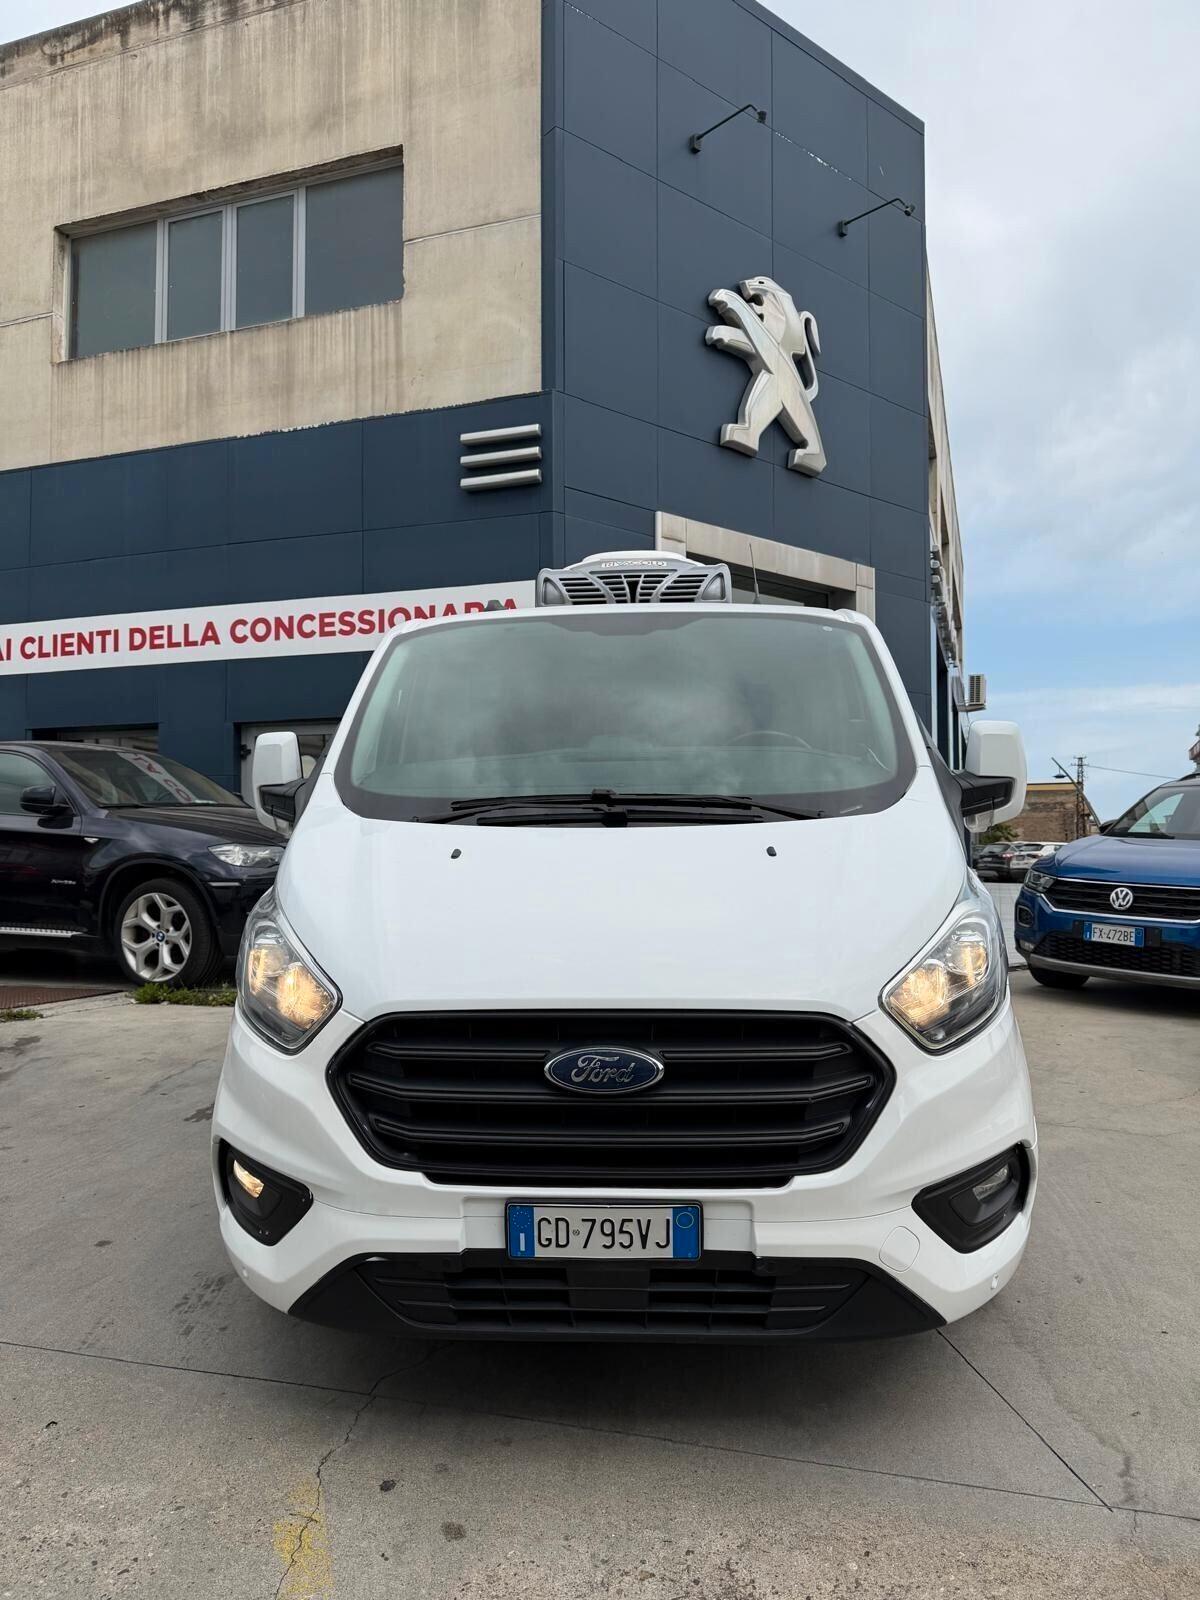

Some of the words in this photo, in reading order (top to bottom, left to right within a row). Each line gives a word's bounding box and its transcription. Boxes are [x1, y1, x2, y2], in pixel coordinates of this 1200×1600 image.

[0, 638, 12, 661] I
[20, 629, 119, 660] CLIENTI
[129, 621, 220, 651] DELLA
[230, 598, 518, 644] CONCESSION
[570, 1054, 636, 1083] Ford
